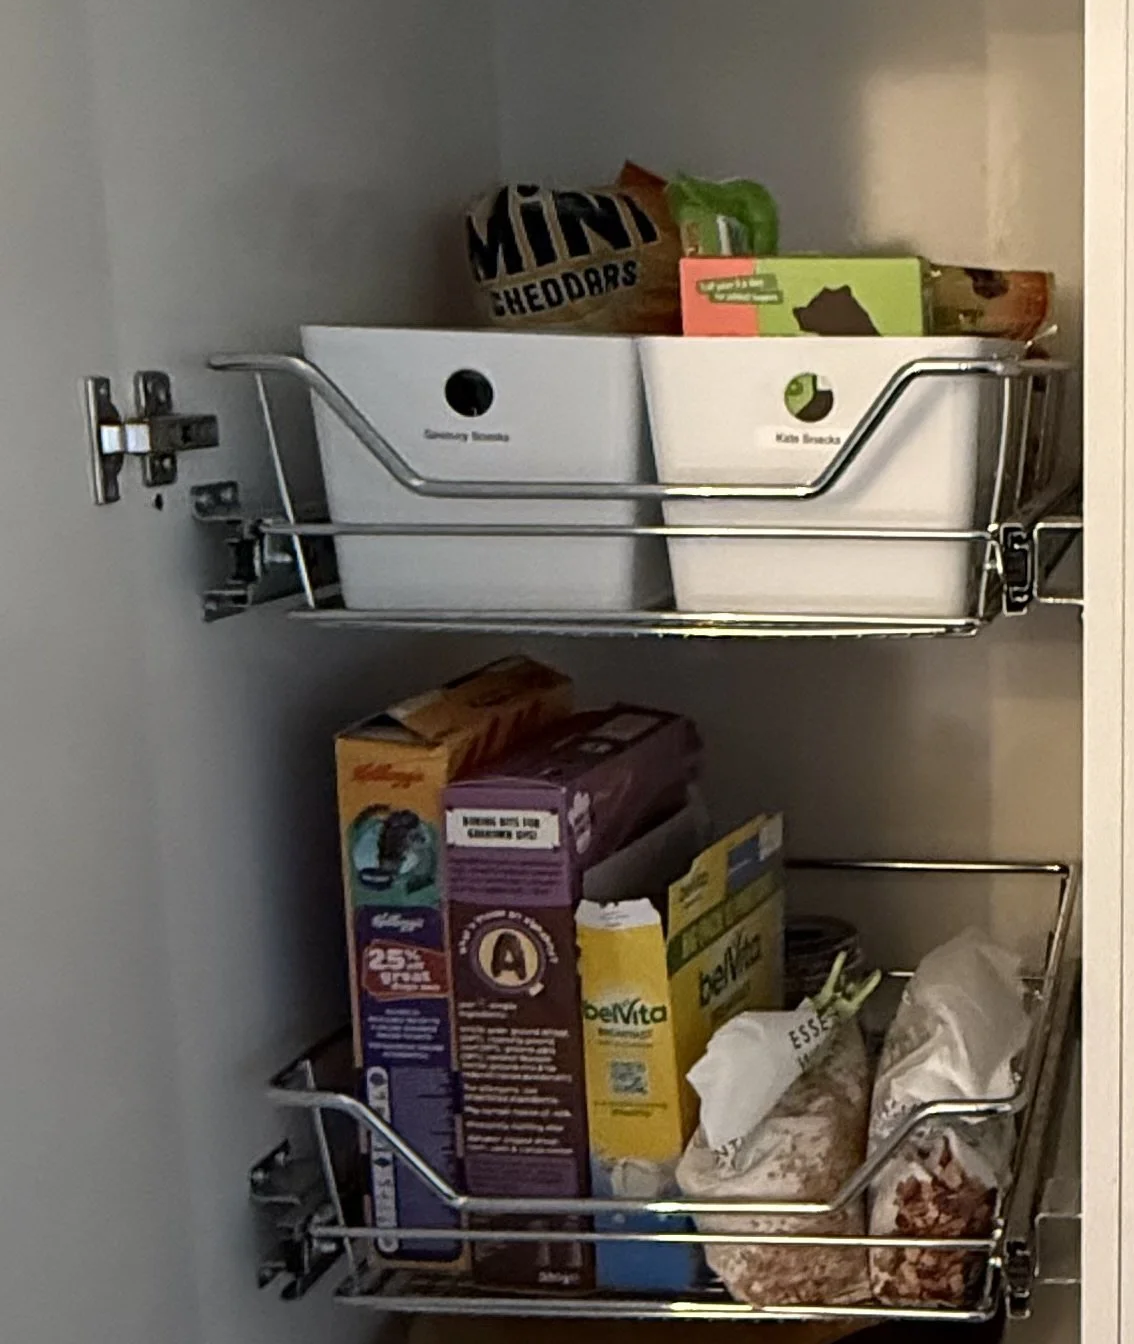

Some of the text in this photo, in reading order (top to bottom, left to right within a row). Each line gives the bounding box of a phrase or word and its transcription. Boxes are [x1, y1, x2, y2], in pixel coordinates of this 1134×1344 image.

[490, 259, 638, 317] CHEDDARS
[492, 931, 527, 980] A
[582, 997, 668, 1025] belVita
